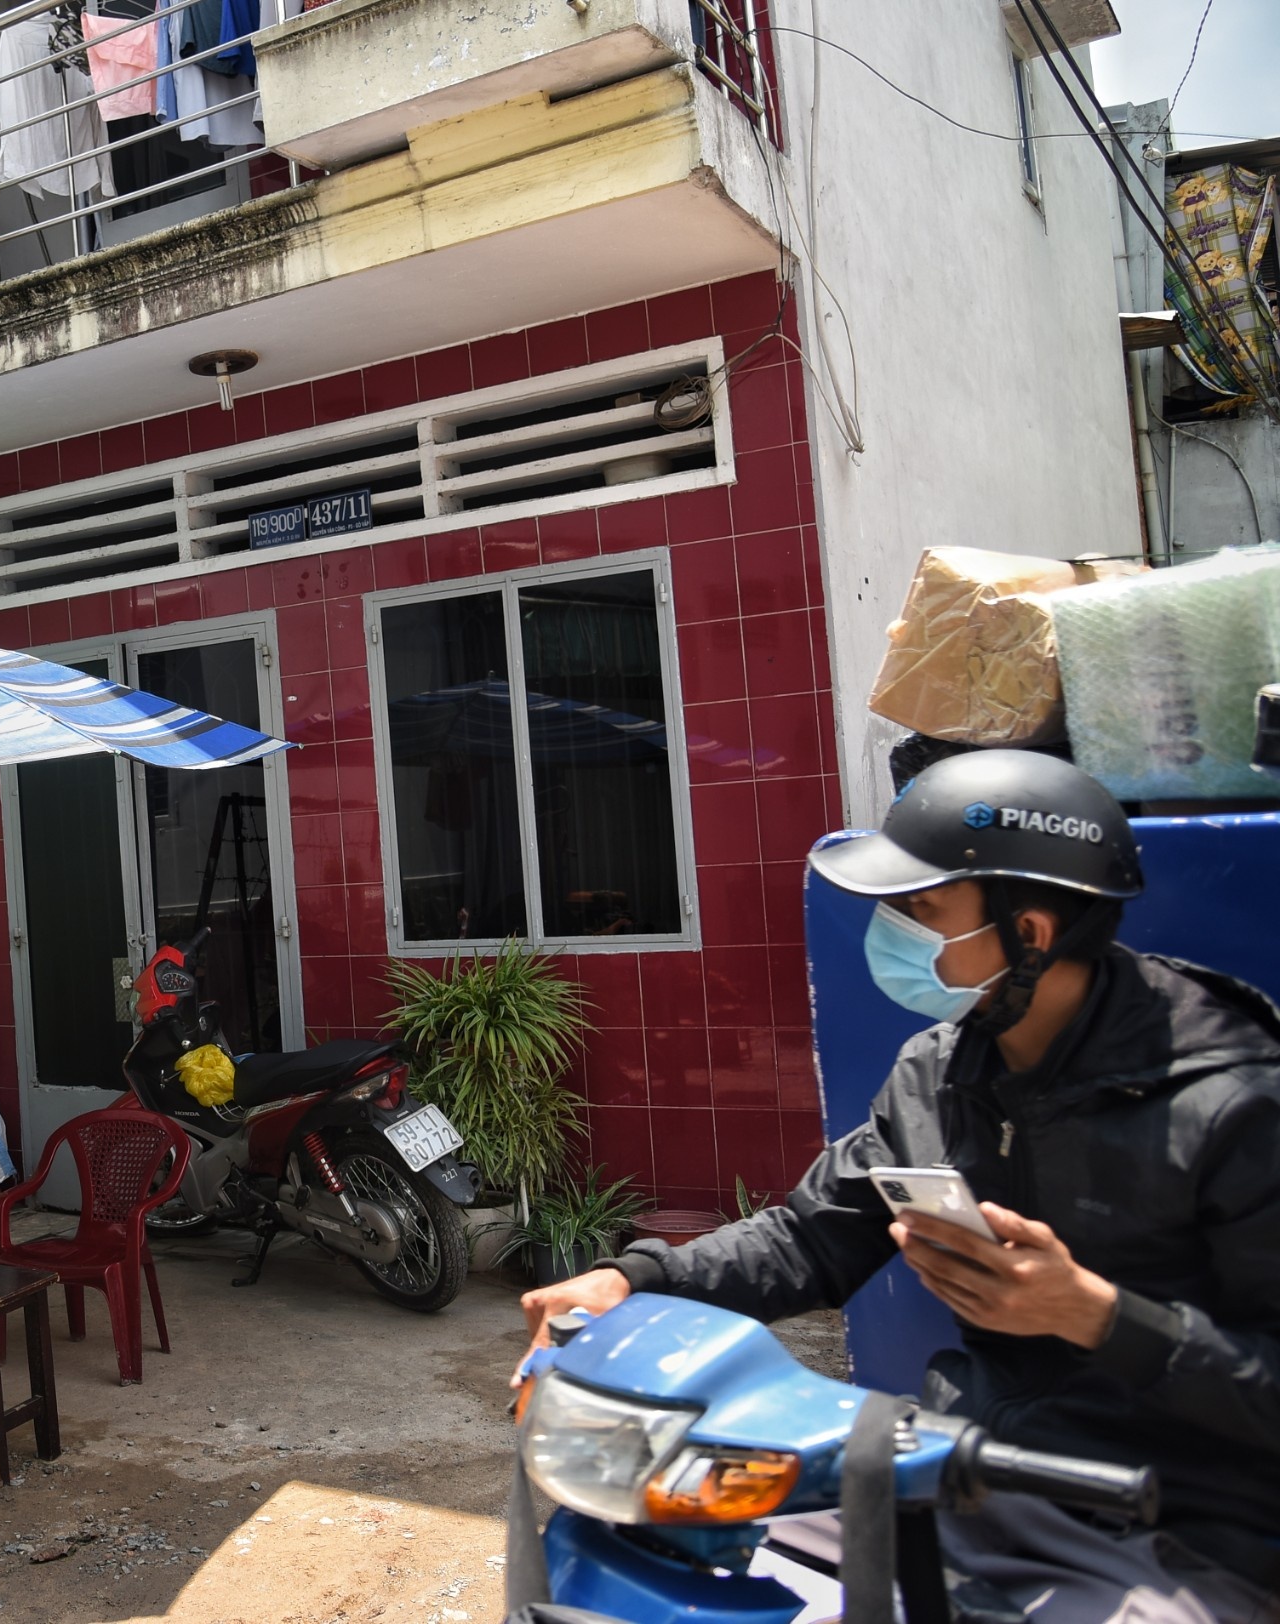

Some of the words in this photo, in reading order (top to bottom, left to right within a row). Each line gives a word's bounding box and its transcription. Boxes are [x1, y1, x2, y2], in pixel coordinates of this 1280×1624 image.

[311, 494, 368, 526] 437/11
[1000, 808, 1104, 843] PIAGGIO
[395, 1111, 438, 1144] 59-L1
[405, 1127, 458, 1165] 607.72
